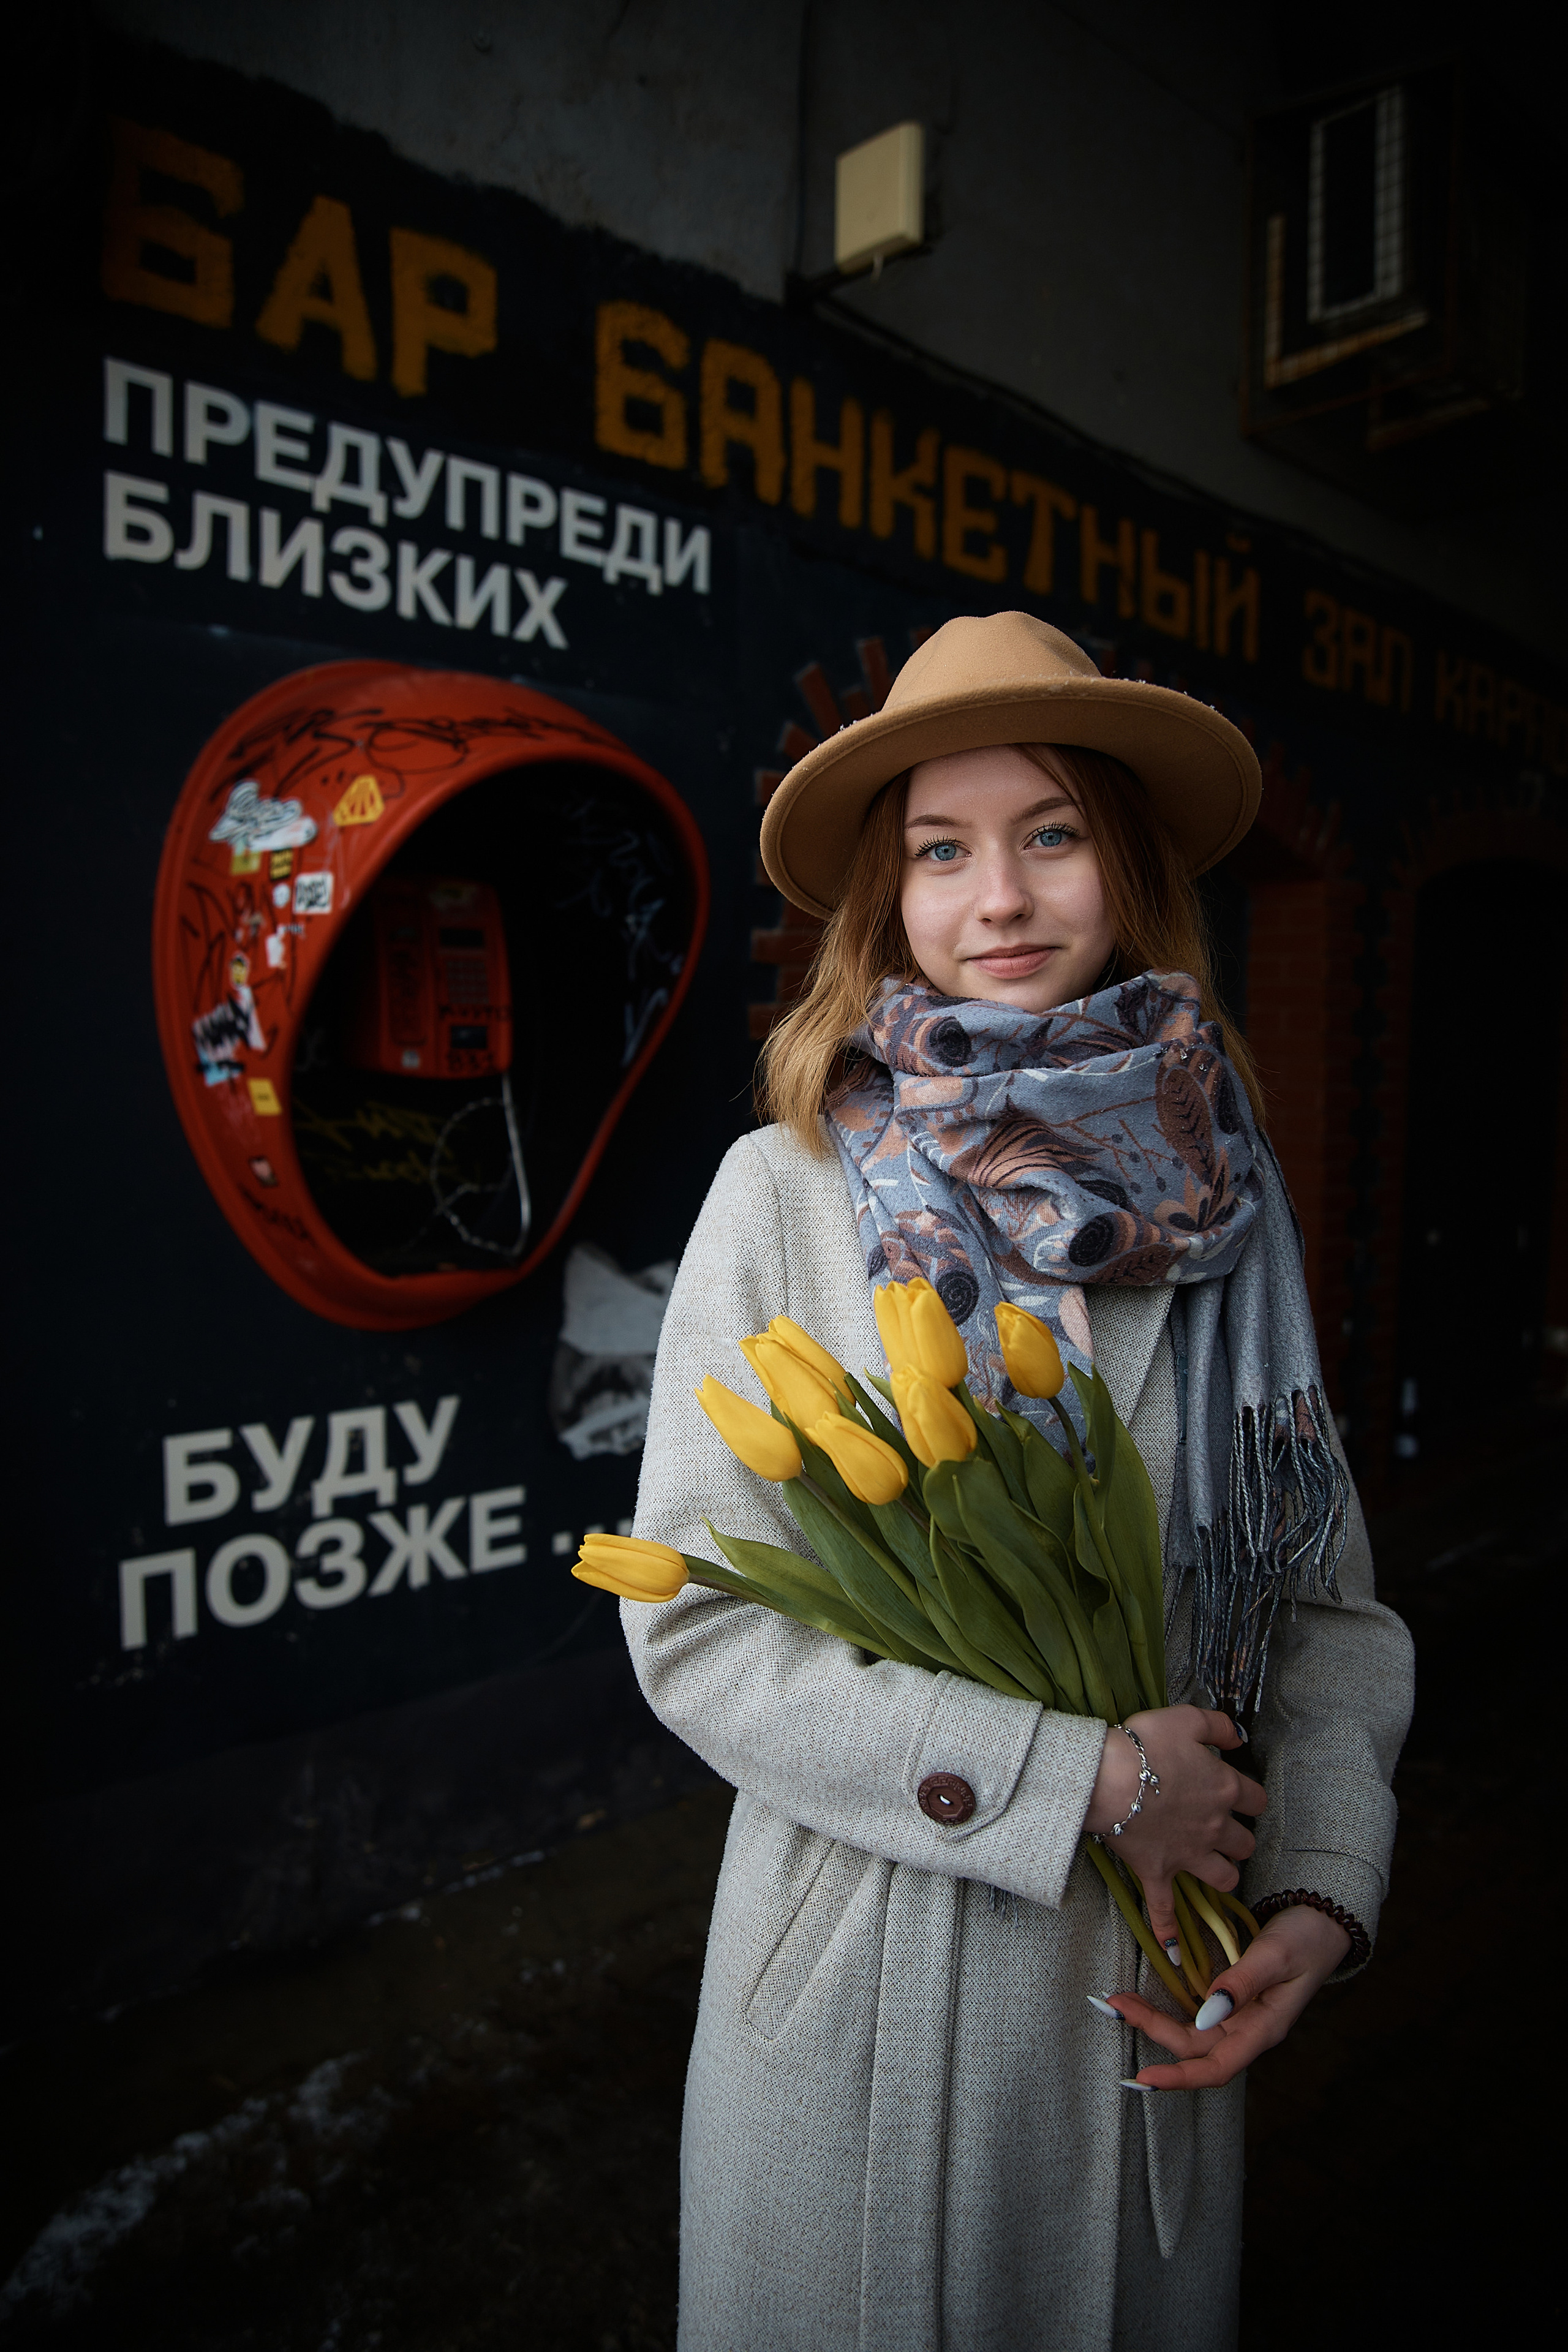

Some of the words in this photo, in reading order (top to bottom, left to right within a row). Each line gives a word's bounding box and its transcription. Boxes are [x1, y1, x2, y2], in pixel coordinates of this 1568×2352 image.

[100, 113, 498, 399] БАР
[593, 298, 1262, 664] БАНКЕТНЫЙ
[1301, 586, 1415, 715] ЗАЛ
[103, 354, 712, 595] ПРЕДУПРЕДИ
[103, 469, 569, 650] БЛИЗКИХ
[161, 1393, 461, 1528] БУДУ
